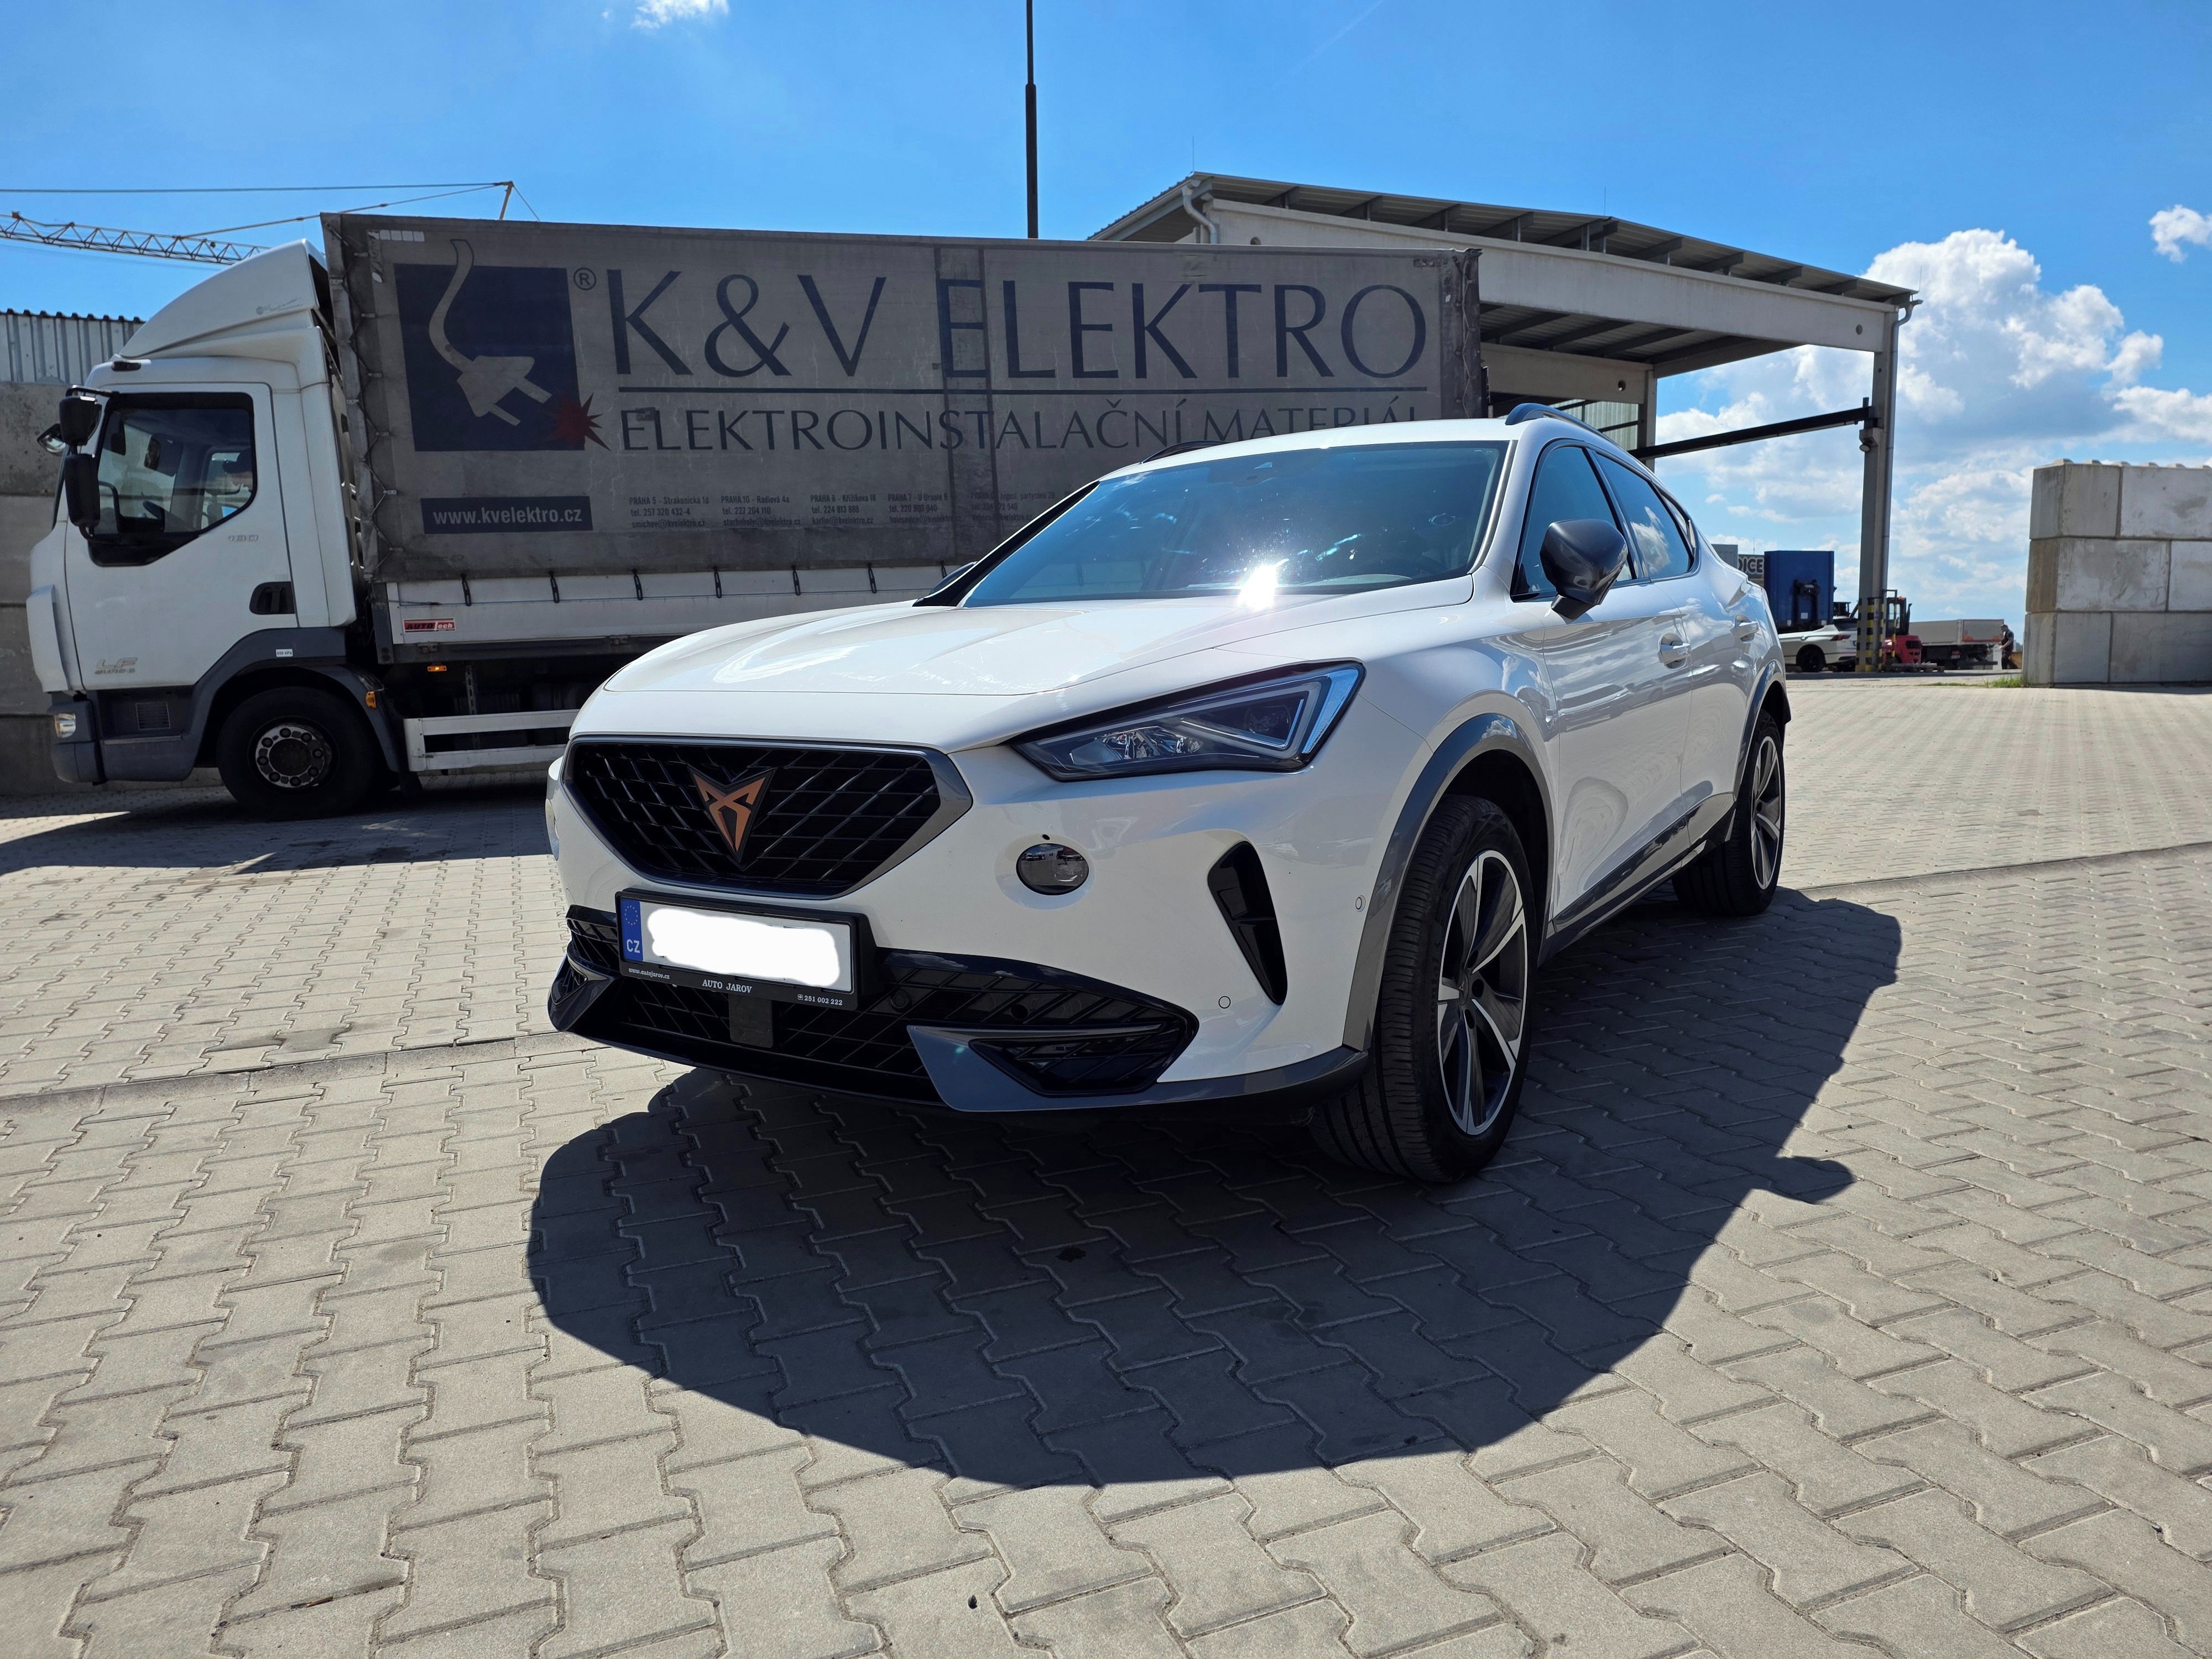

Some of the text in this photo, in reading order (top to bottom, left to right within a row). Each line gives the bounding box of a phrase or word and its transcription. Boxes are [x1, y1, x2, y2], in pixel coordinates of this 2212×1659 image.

[607, 269, 1427, 379] K&V ELEKTRO
[620, 398, 1187, 450] ELEKTROINSTALAČNÍ
[629, 497, 650, 505] PRAHA
[652, 497, 656, 505] 5
[721, 495, 742, 504] PRAHA
[743, 495, 750, 504] 10
[811, 494, 830, 503] PRAHA
[888, 493, 907, 502] PRAHA
[644, 508, 655, 516] 257
[657, 508, 669, 516] 320
[734, 507, 745, 515] 227
[748, 507, 759, 515] 204
[761, 507, 771, 515] 110
[823, 505, 835, 514] 224
[837, 505, 847, 514] 813
[900, 504, 911, 513] 220
[432, 507, 583, 525] www.kvelektro.cz
[626, 938, 640, 954] CZ
[628, 967, 670, 980] www.autojarov.cz
[702, 979, 752, 993] AUTO JAROV
